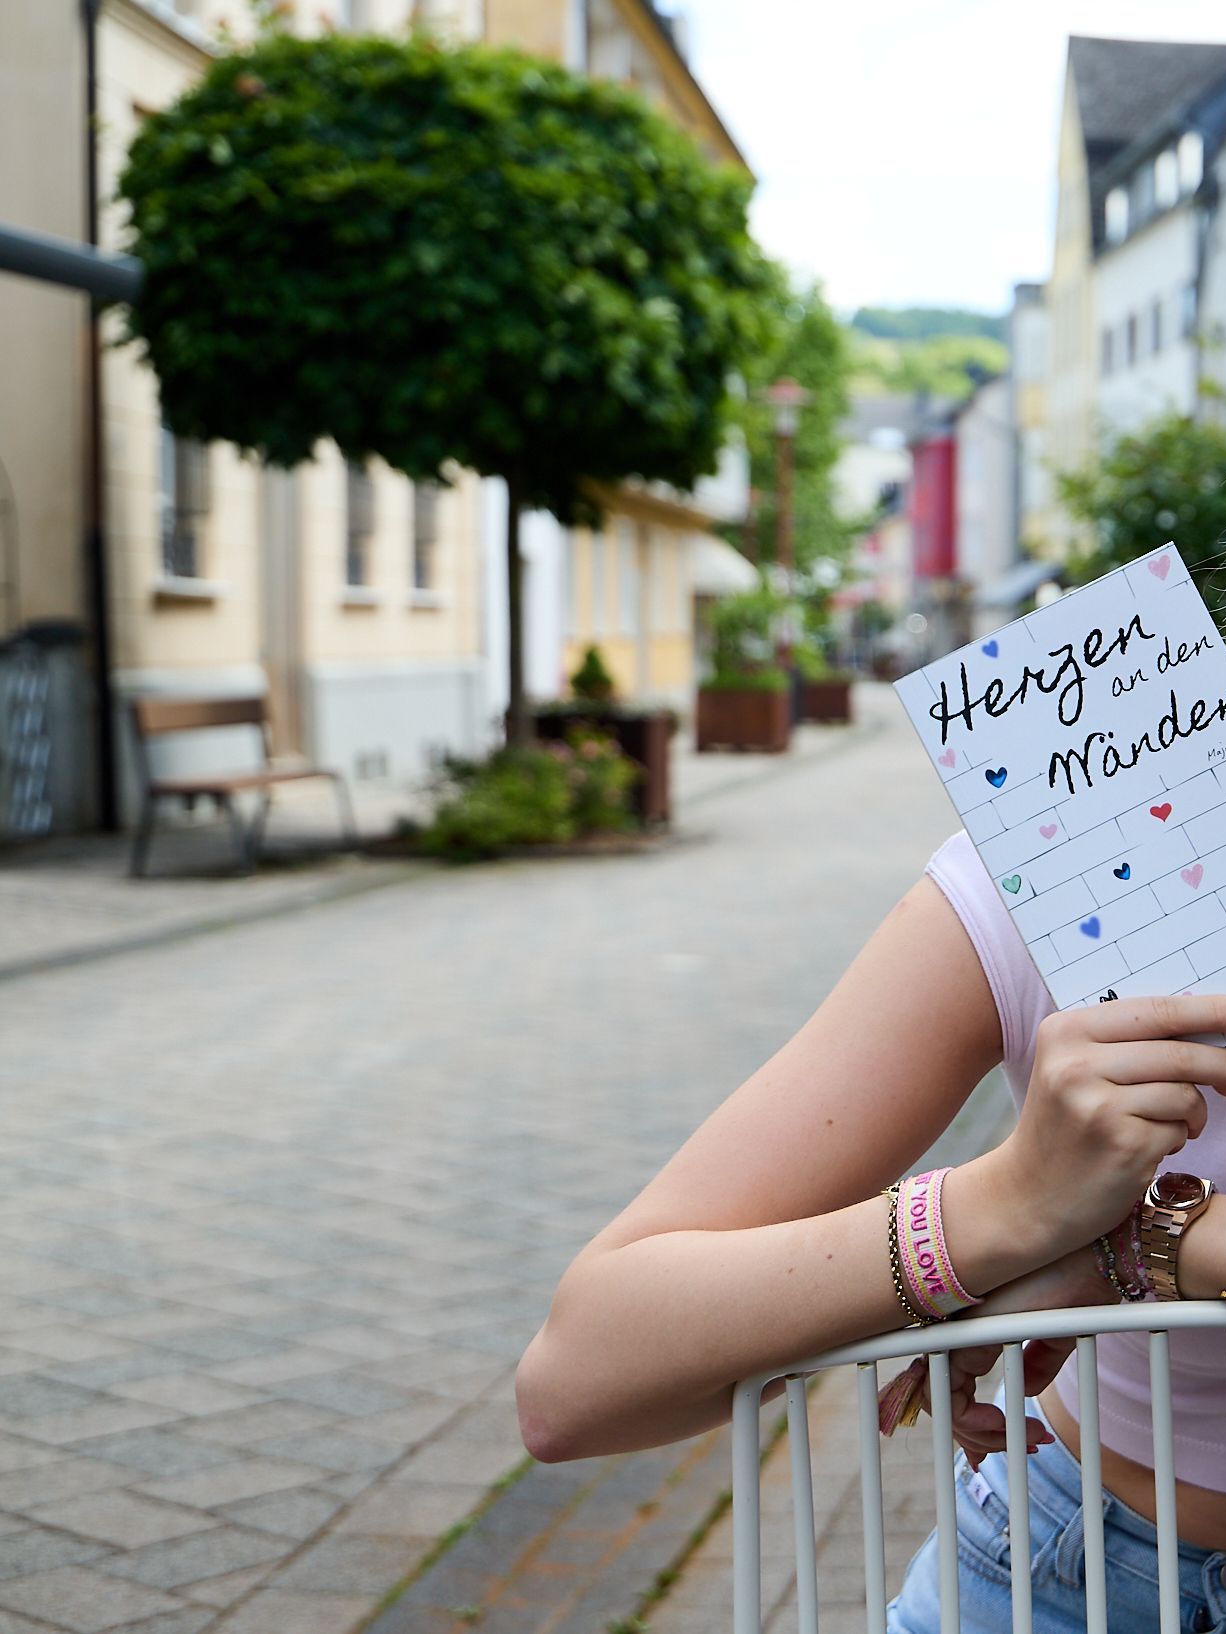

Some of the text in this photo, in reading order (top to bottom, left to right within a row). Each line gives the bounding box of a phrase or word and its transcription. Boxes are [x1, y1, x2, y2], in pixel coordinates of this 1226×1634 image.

[928, 613, 1156, 746] Herzen
[1111, 635, 1214, 698] an den
[910, 1189, 929, 1232] YOU
[913, 1237, 948, 1297] LOVE
